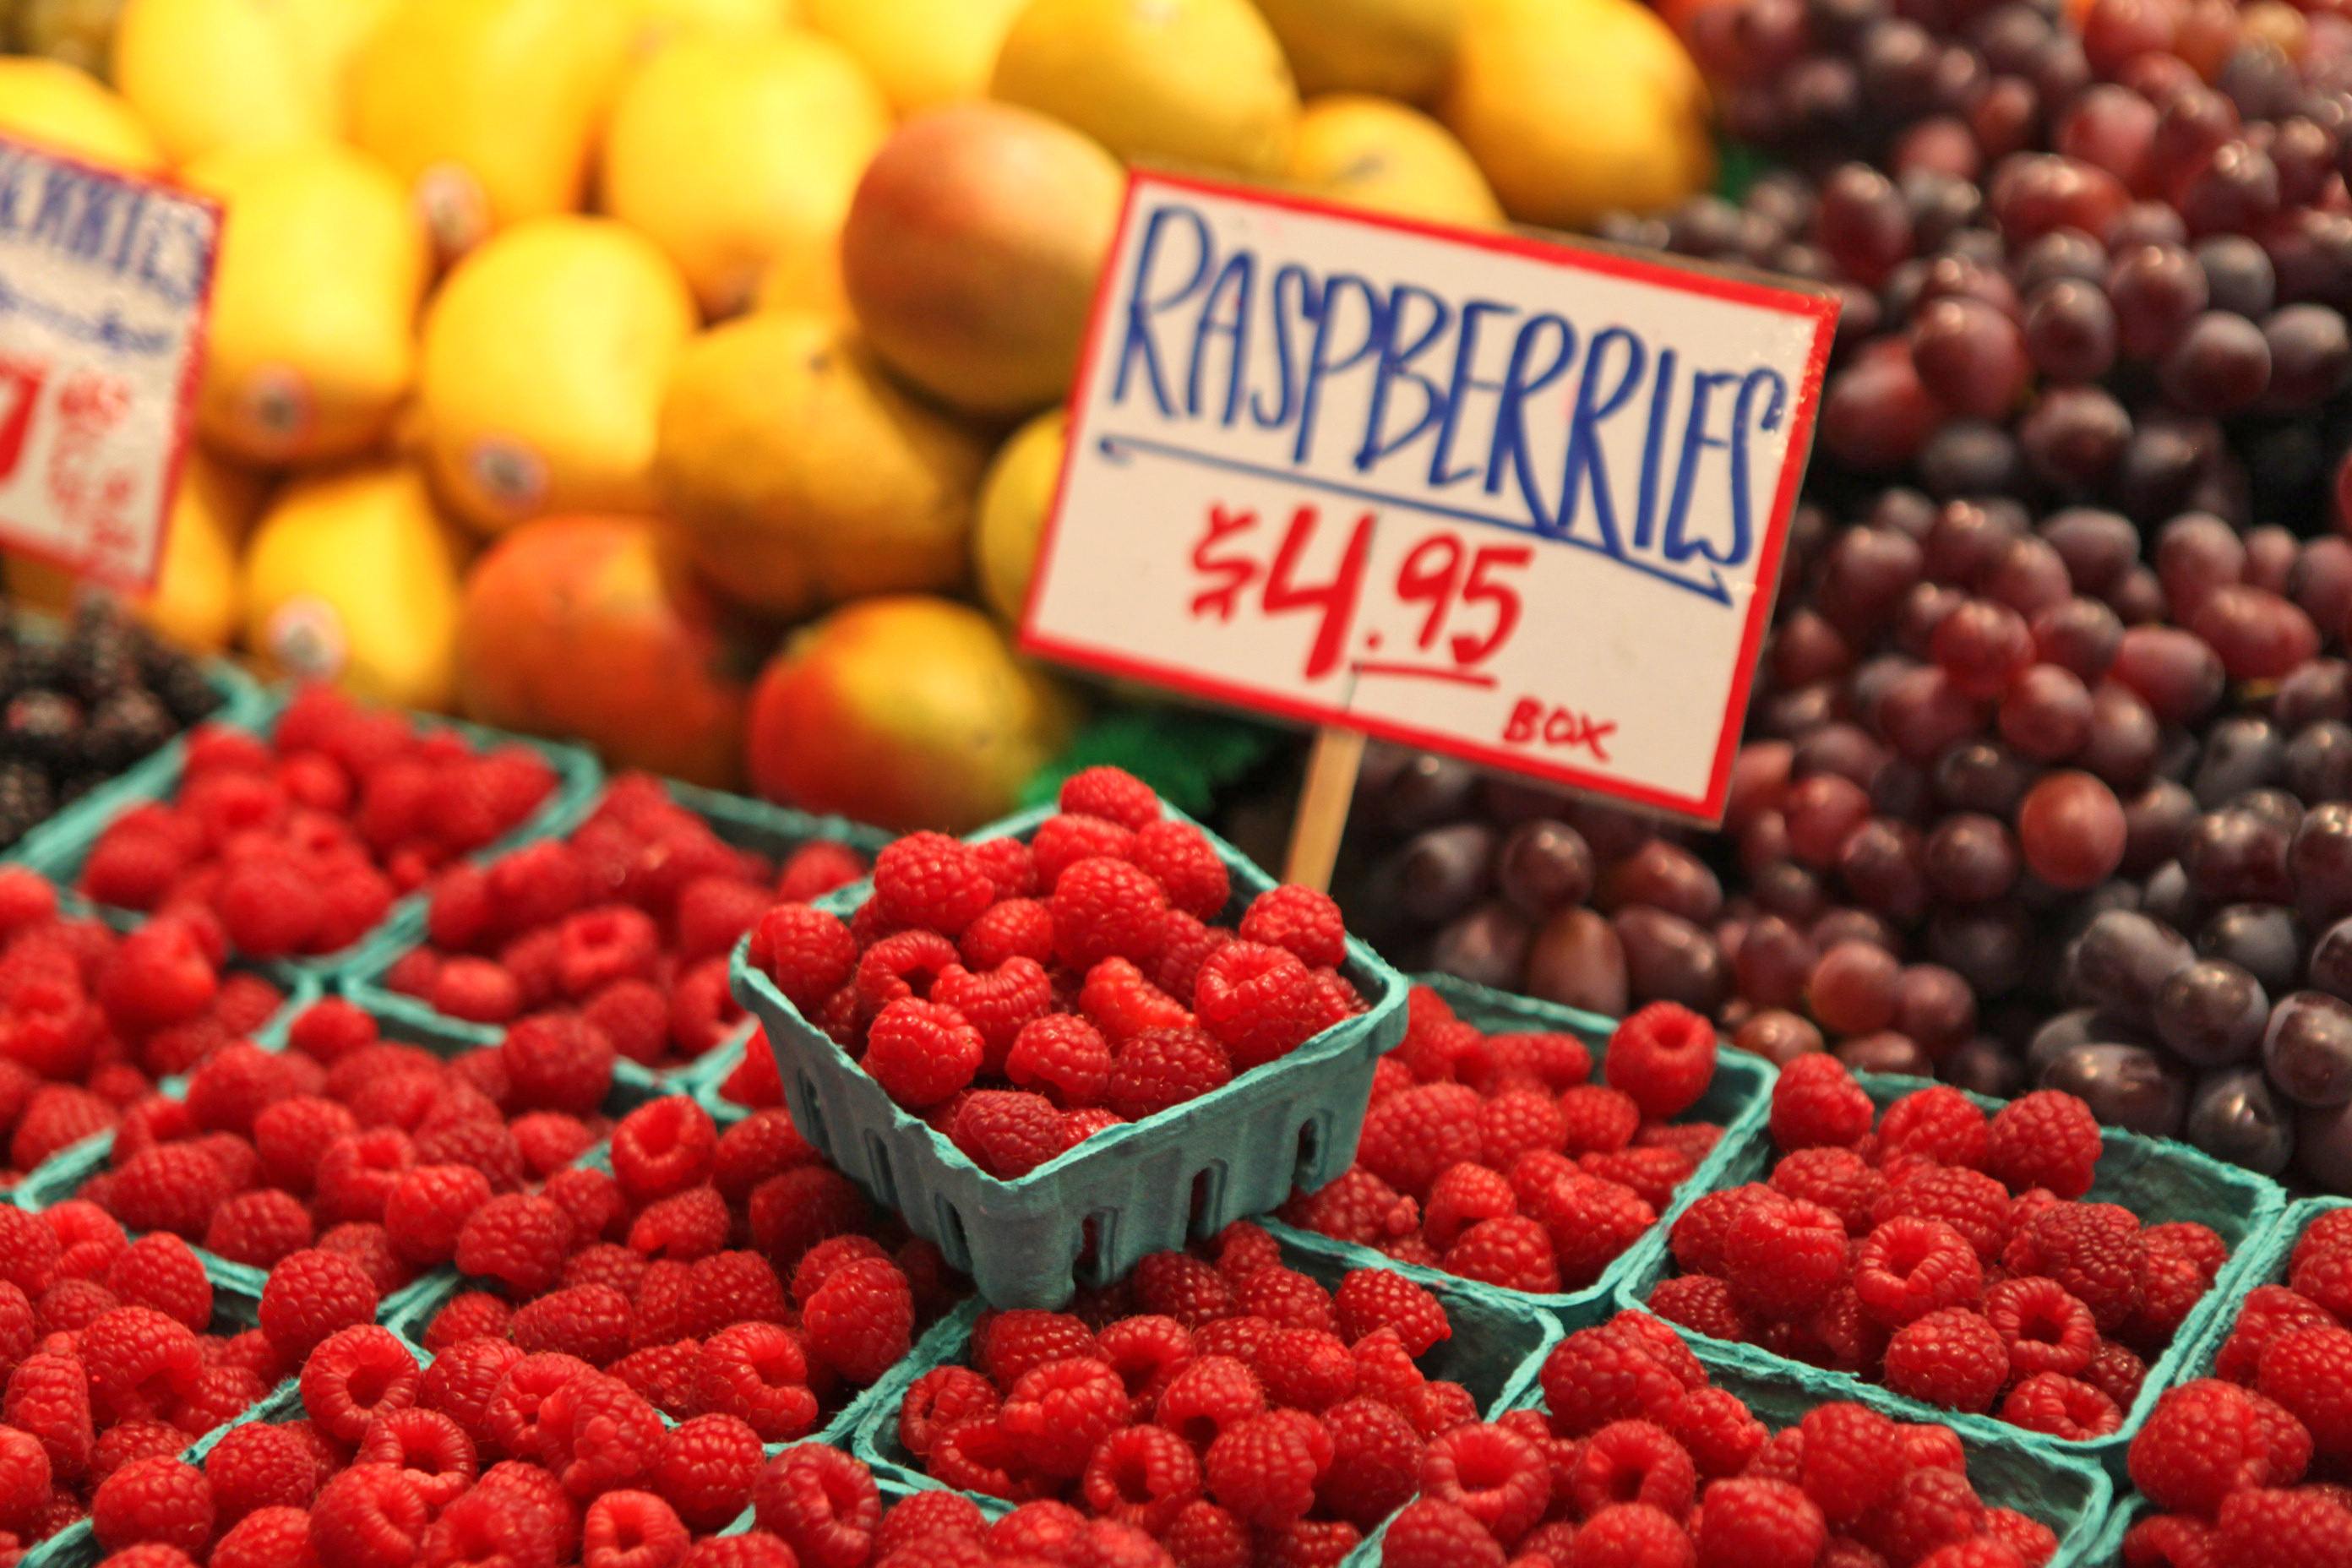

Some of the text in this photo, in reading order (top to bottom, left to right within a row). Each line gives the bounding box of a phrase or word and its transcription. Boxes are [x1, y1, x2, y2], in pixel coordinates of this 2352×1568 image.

[1112, 205, 1787, 566] RASPBERRIES
[1187, 506, 1534, 682] $4.95
[1502, 696, 1617, 762] BOX
